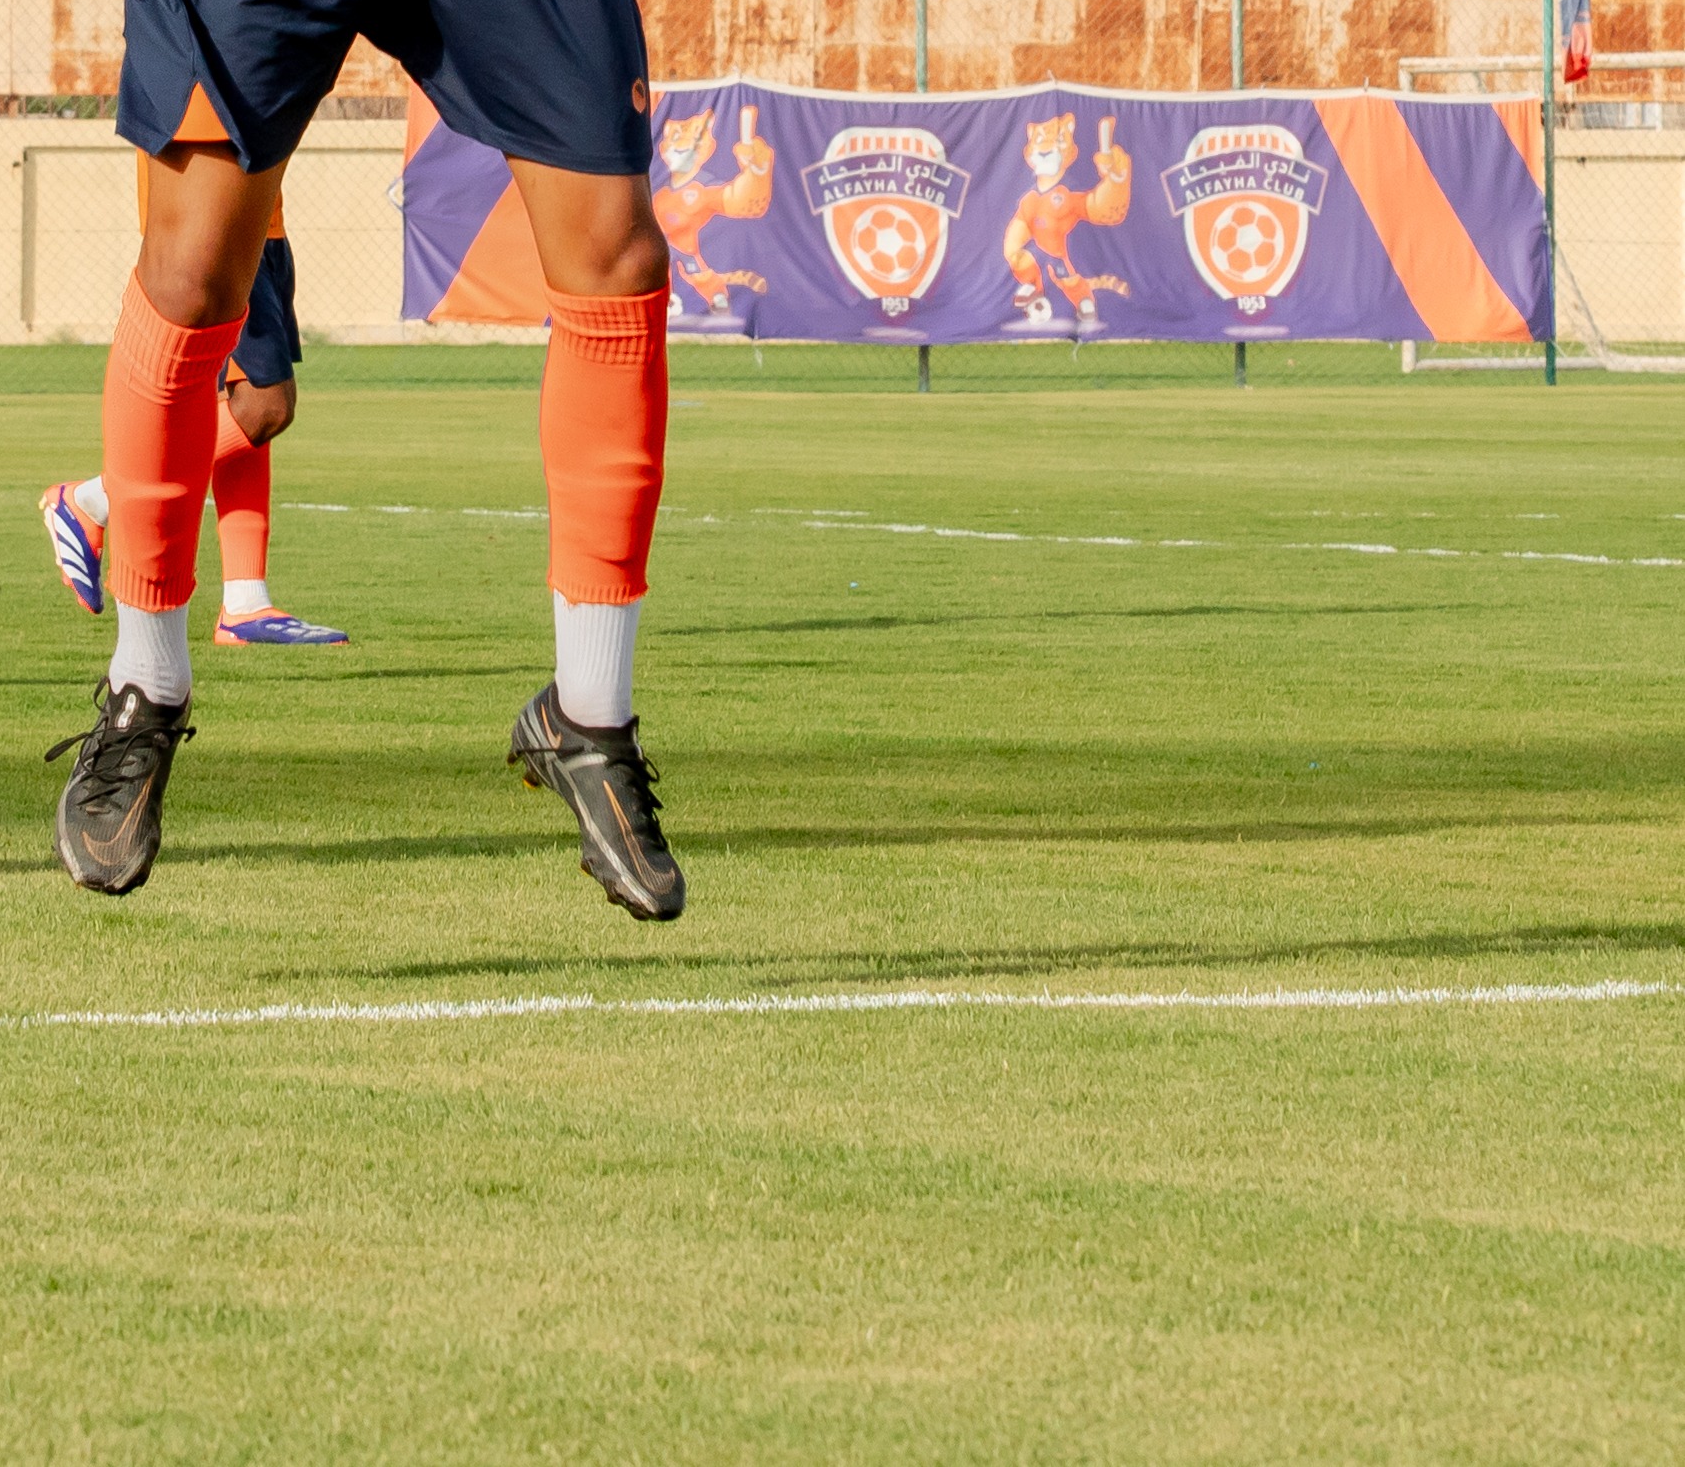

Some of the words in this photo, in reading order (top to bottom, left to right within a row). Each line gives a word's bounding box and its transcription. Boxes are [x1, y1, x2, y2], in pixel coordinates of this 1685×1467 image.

[905, 164, 953, 188] نادي
[1264, 160, 1312, 184] نادي
[823, 179, 897, 204] ALFAYHA
[904, 182, 946, 205] CLUB
[1185, 176, 1256, 204] ALFAYHA
[1263, 178, 1305, 203] CLUB
